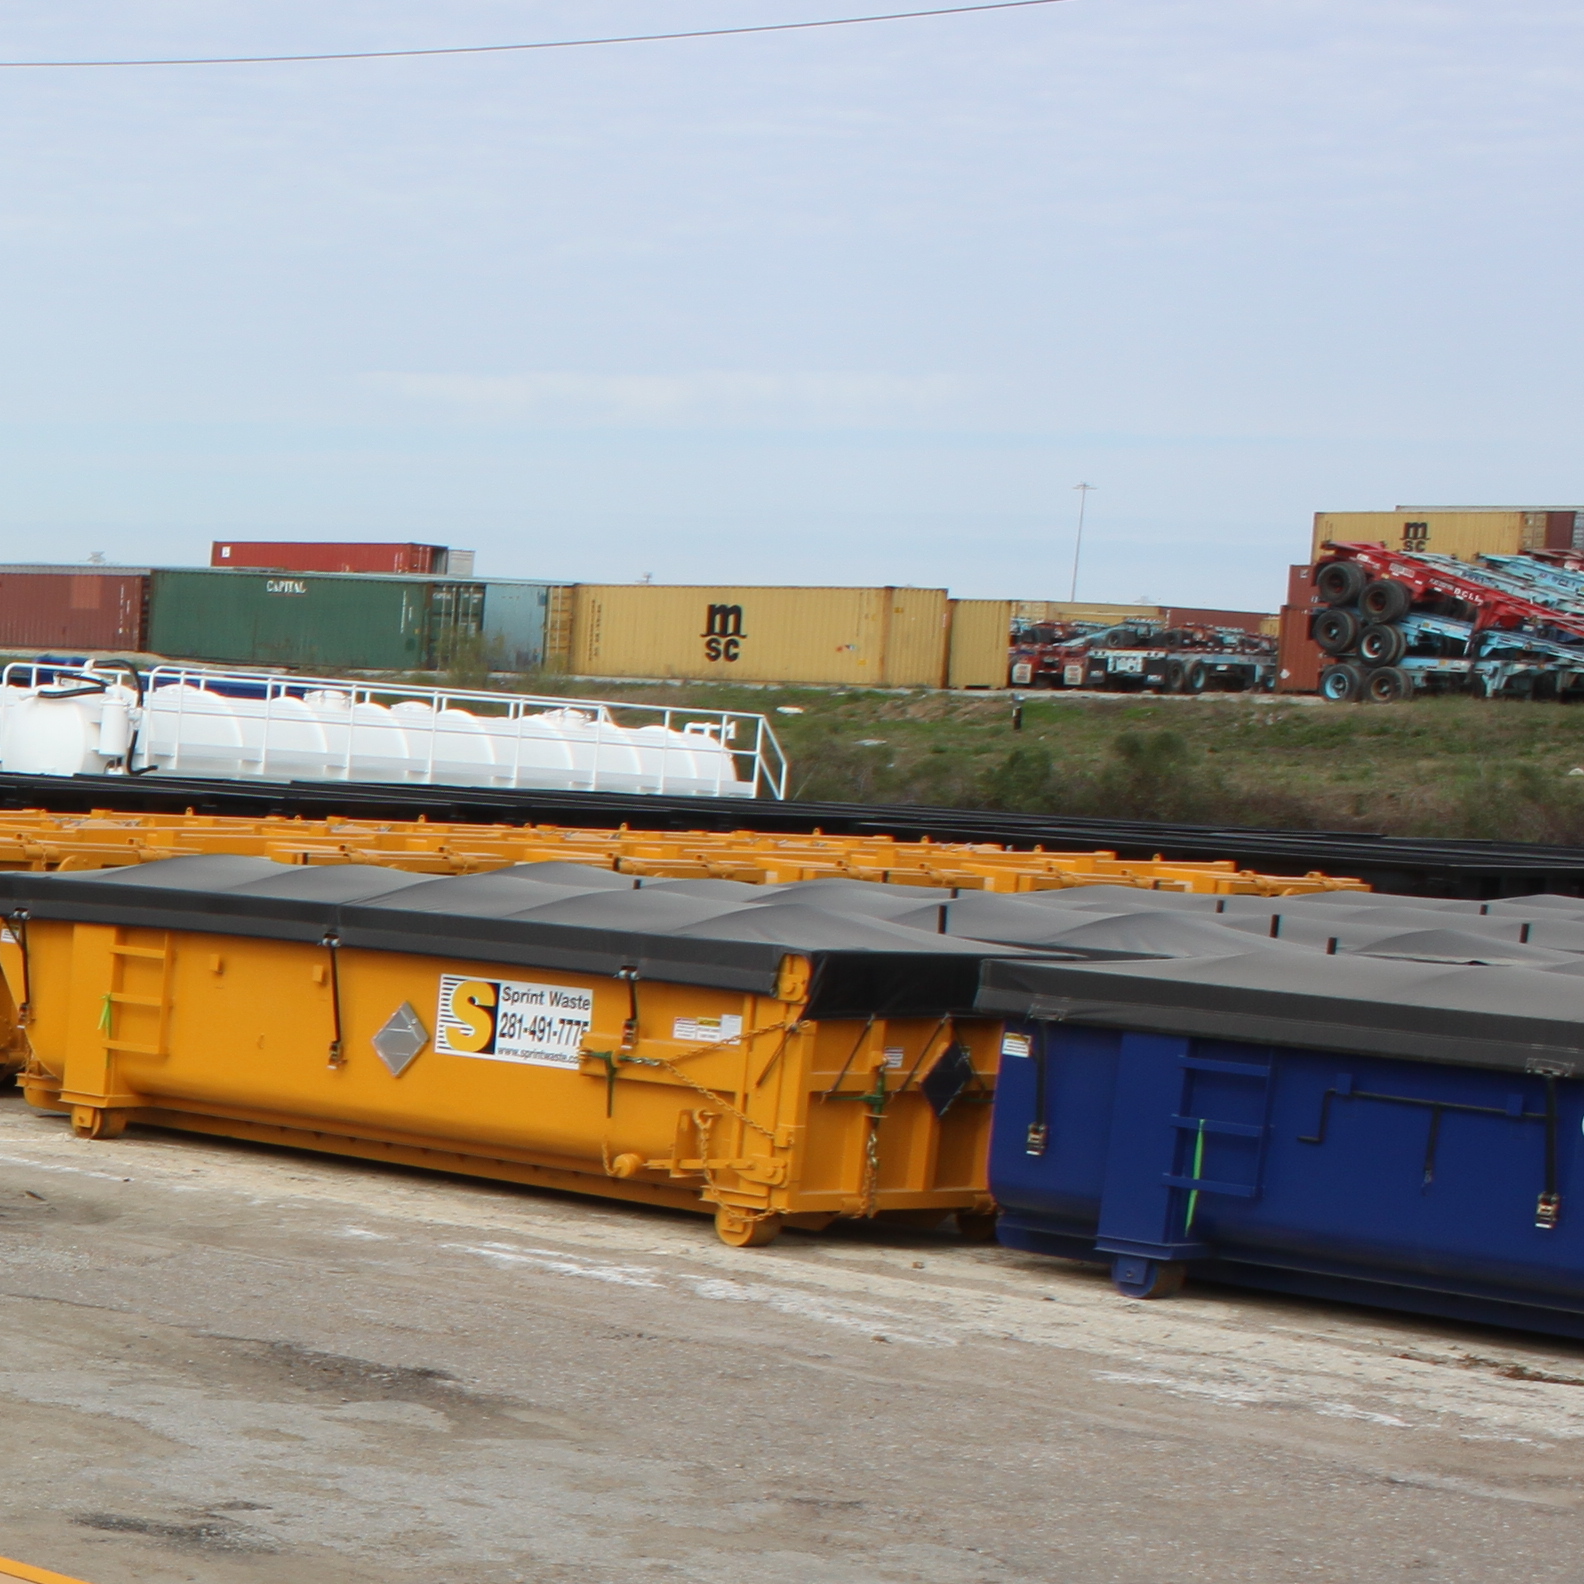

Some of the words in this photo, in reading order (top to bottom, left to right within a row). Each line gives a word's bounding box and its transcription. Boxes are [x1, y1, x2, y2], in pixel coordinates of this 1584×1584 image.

[266, 579, 307, 594] CAPITAL
[501, 986, 545, 1007] Sprint
[549, 990, 591, 1011] Waste
[497, 1047, 579, 1064] www.sprintwaste.co
